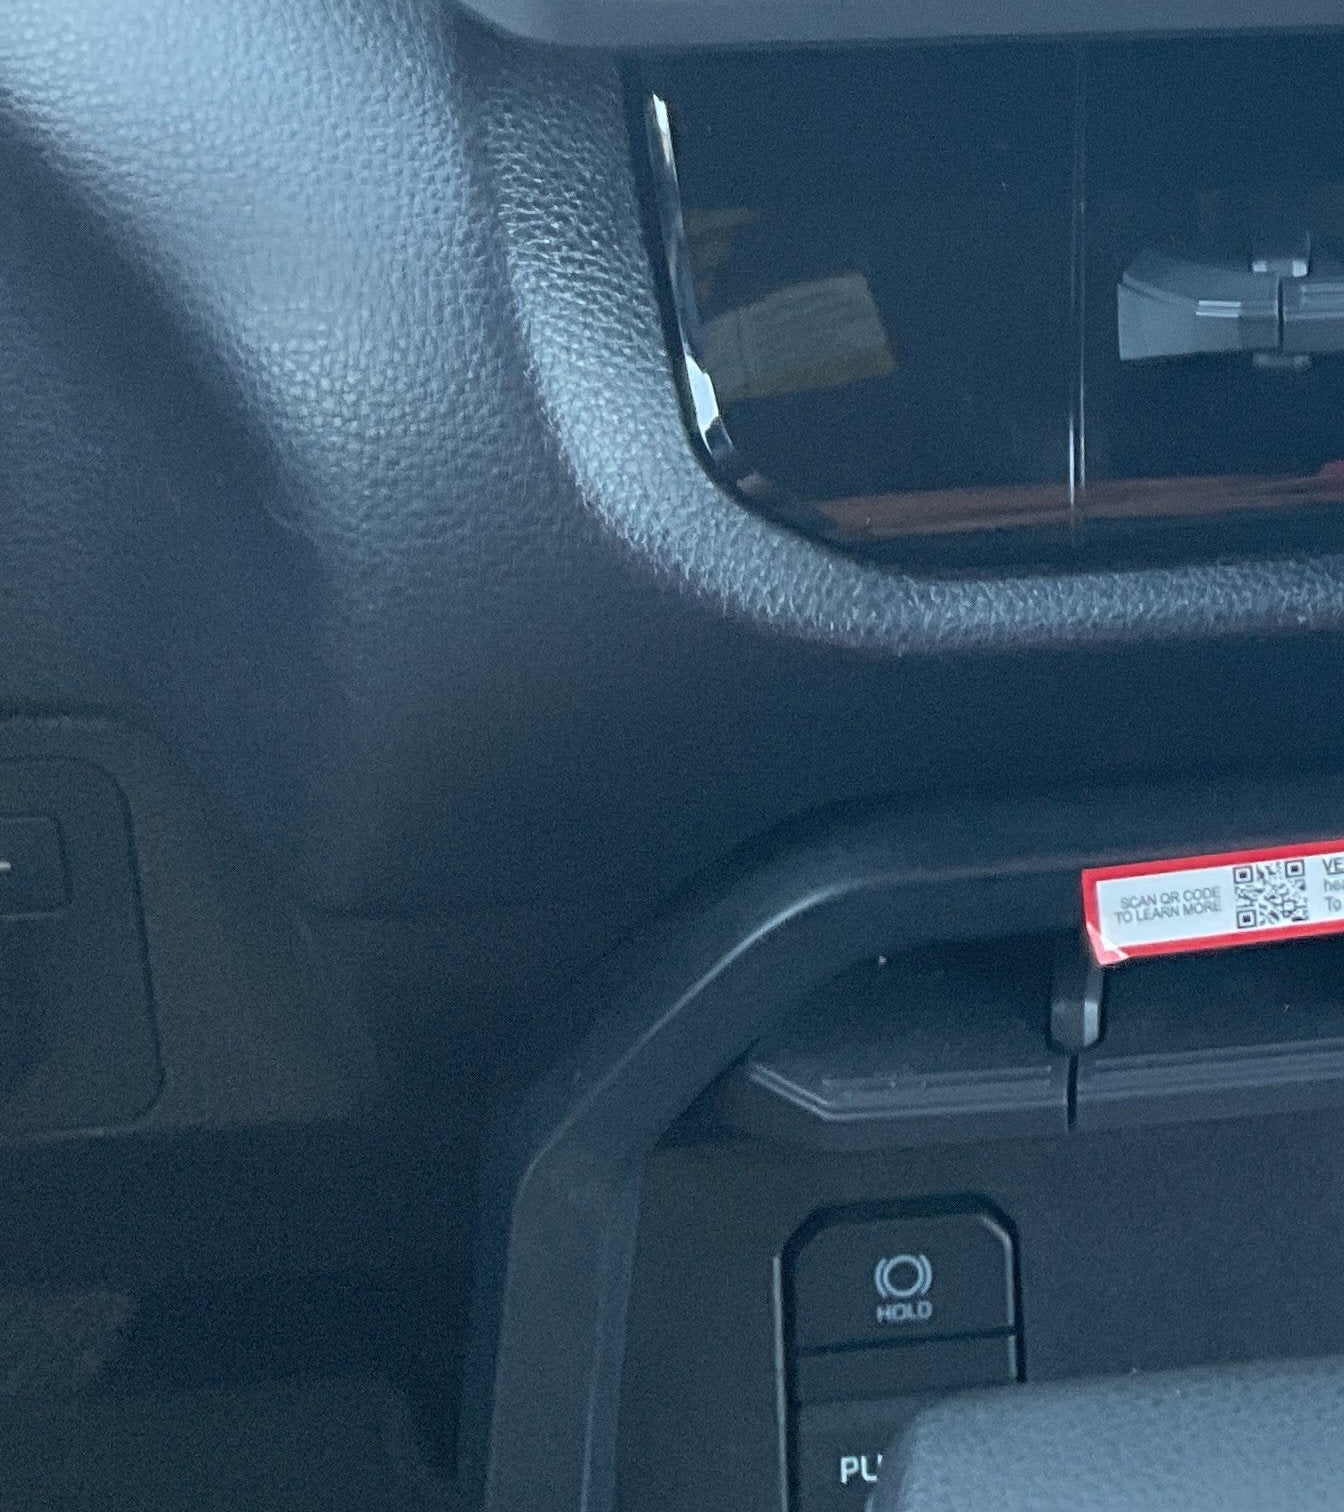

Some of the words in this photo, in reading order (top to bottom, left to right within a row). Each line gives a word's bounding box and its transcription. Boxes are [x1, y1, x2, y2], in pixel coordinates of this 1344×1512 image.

[1120, 893, 1158, 910] SCAN
[1160, 890, 1181, 907] QR
[1183, 886, 1222, 904] CODE
[1325, 895, 1342, 912] To
[1115, 910, 1133, 925] TO
[1136, 905, 1181, 923] LEARN
[1183, 900, 1223, 917] MORE
[876, 1300, 934, 1323] HOLD
